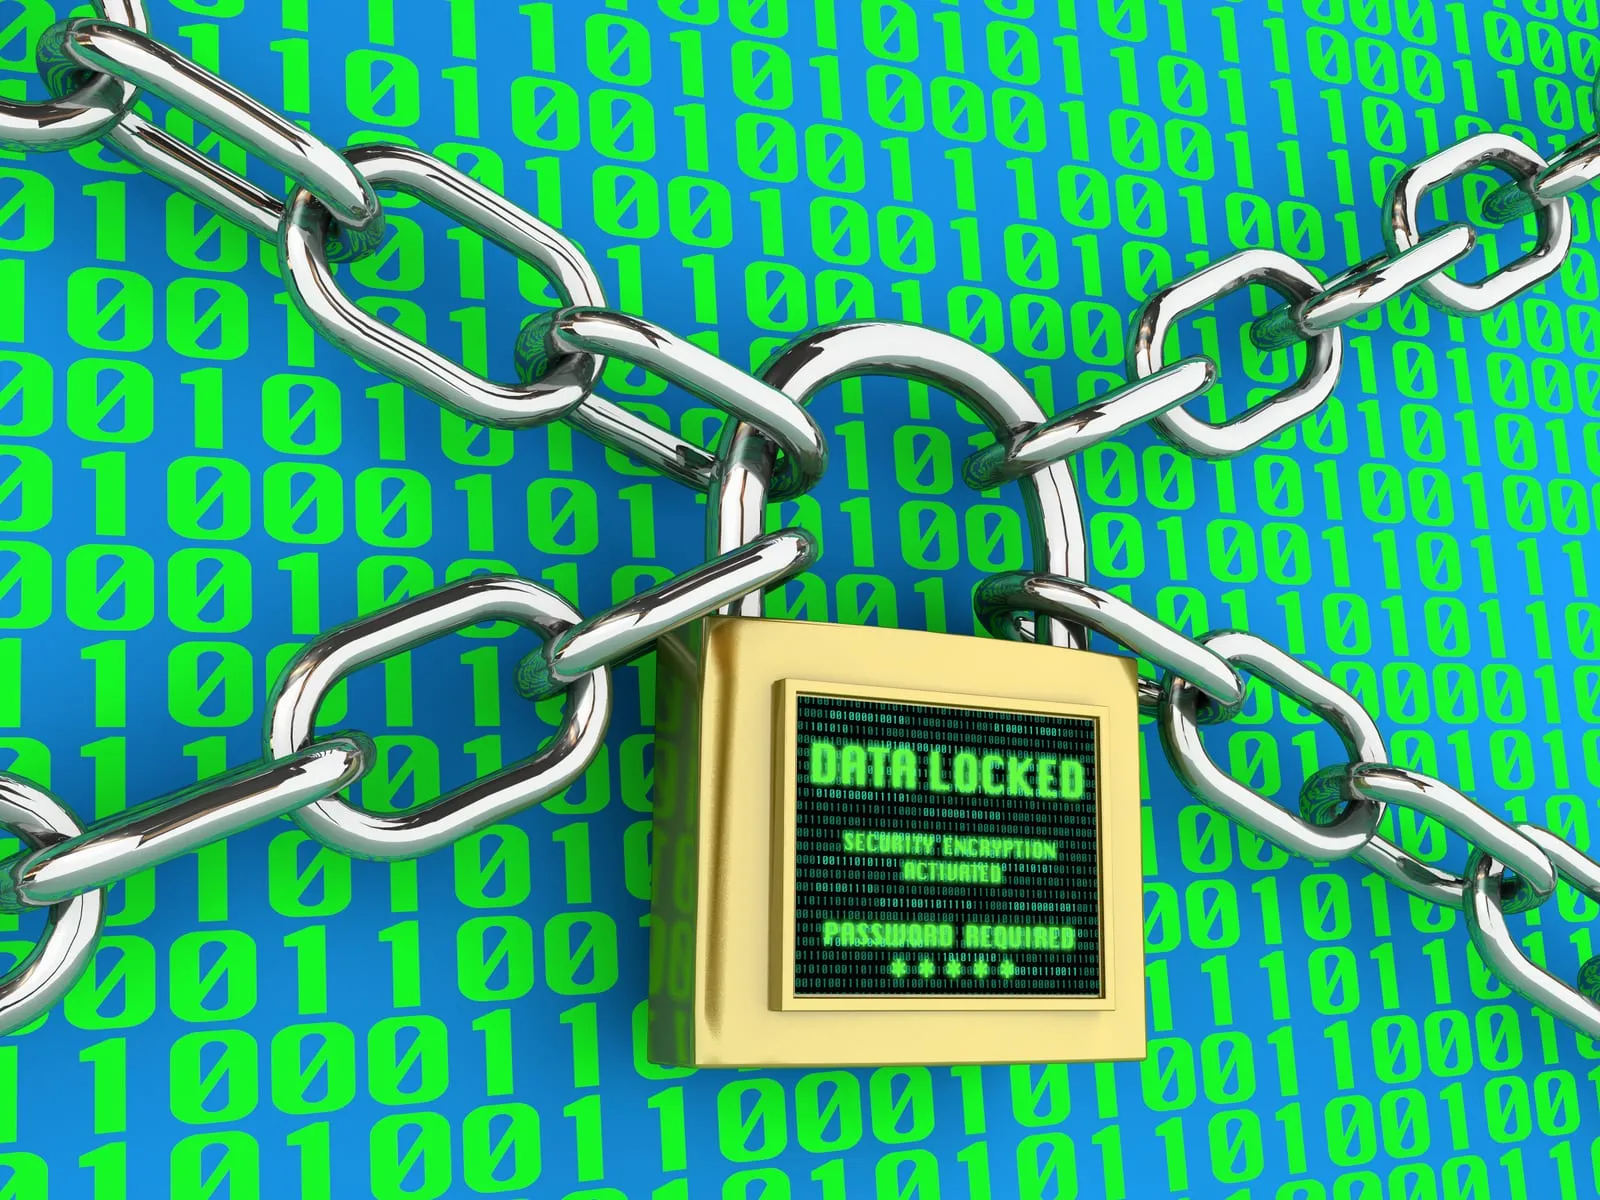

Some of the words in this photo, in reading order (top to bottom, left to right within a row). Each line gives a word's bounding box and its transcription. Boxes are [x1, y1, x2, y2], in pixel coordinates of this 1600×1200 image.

[811, 742, 916, 789] DATA
[929, 750, 1084, 800] LOCKED
[843, 832, 935, 855] SECURITY
[941, 837, 1057, 861] ENCRYPTION
[903, 862, 1001, 884] ACTIVATED
[823, 921, 953, 948] PASSWORD
[965, 925, 1076, 950] REQUIRED
